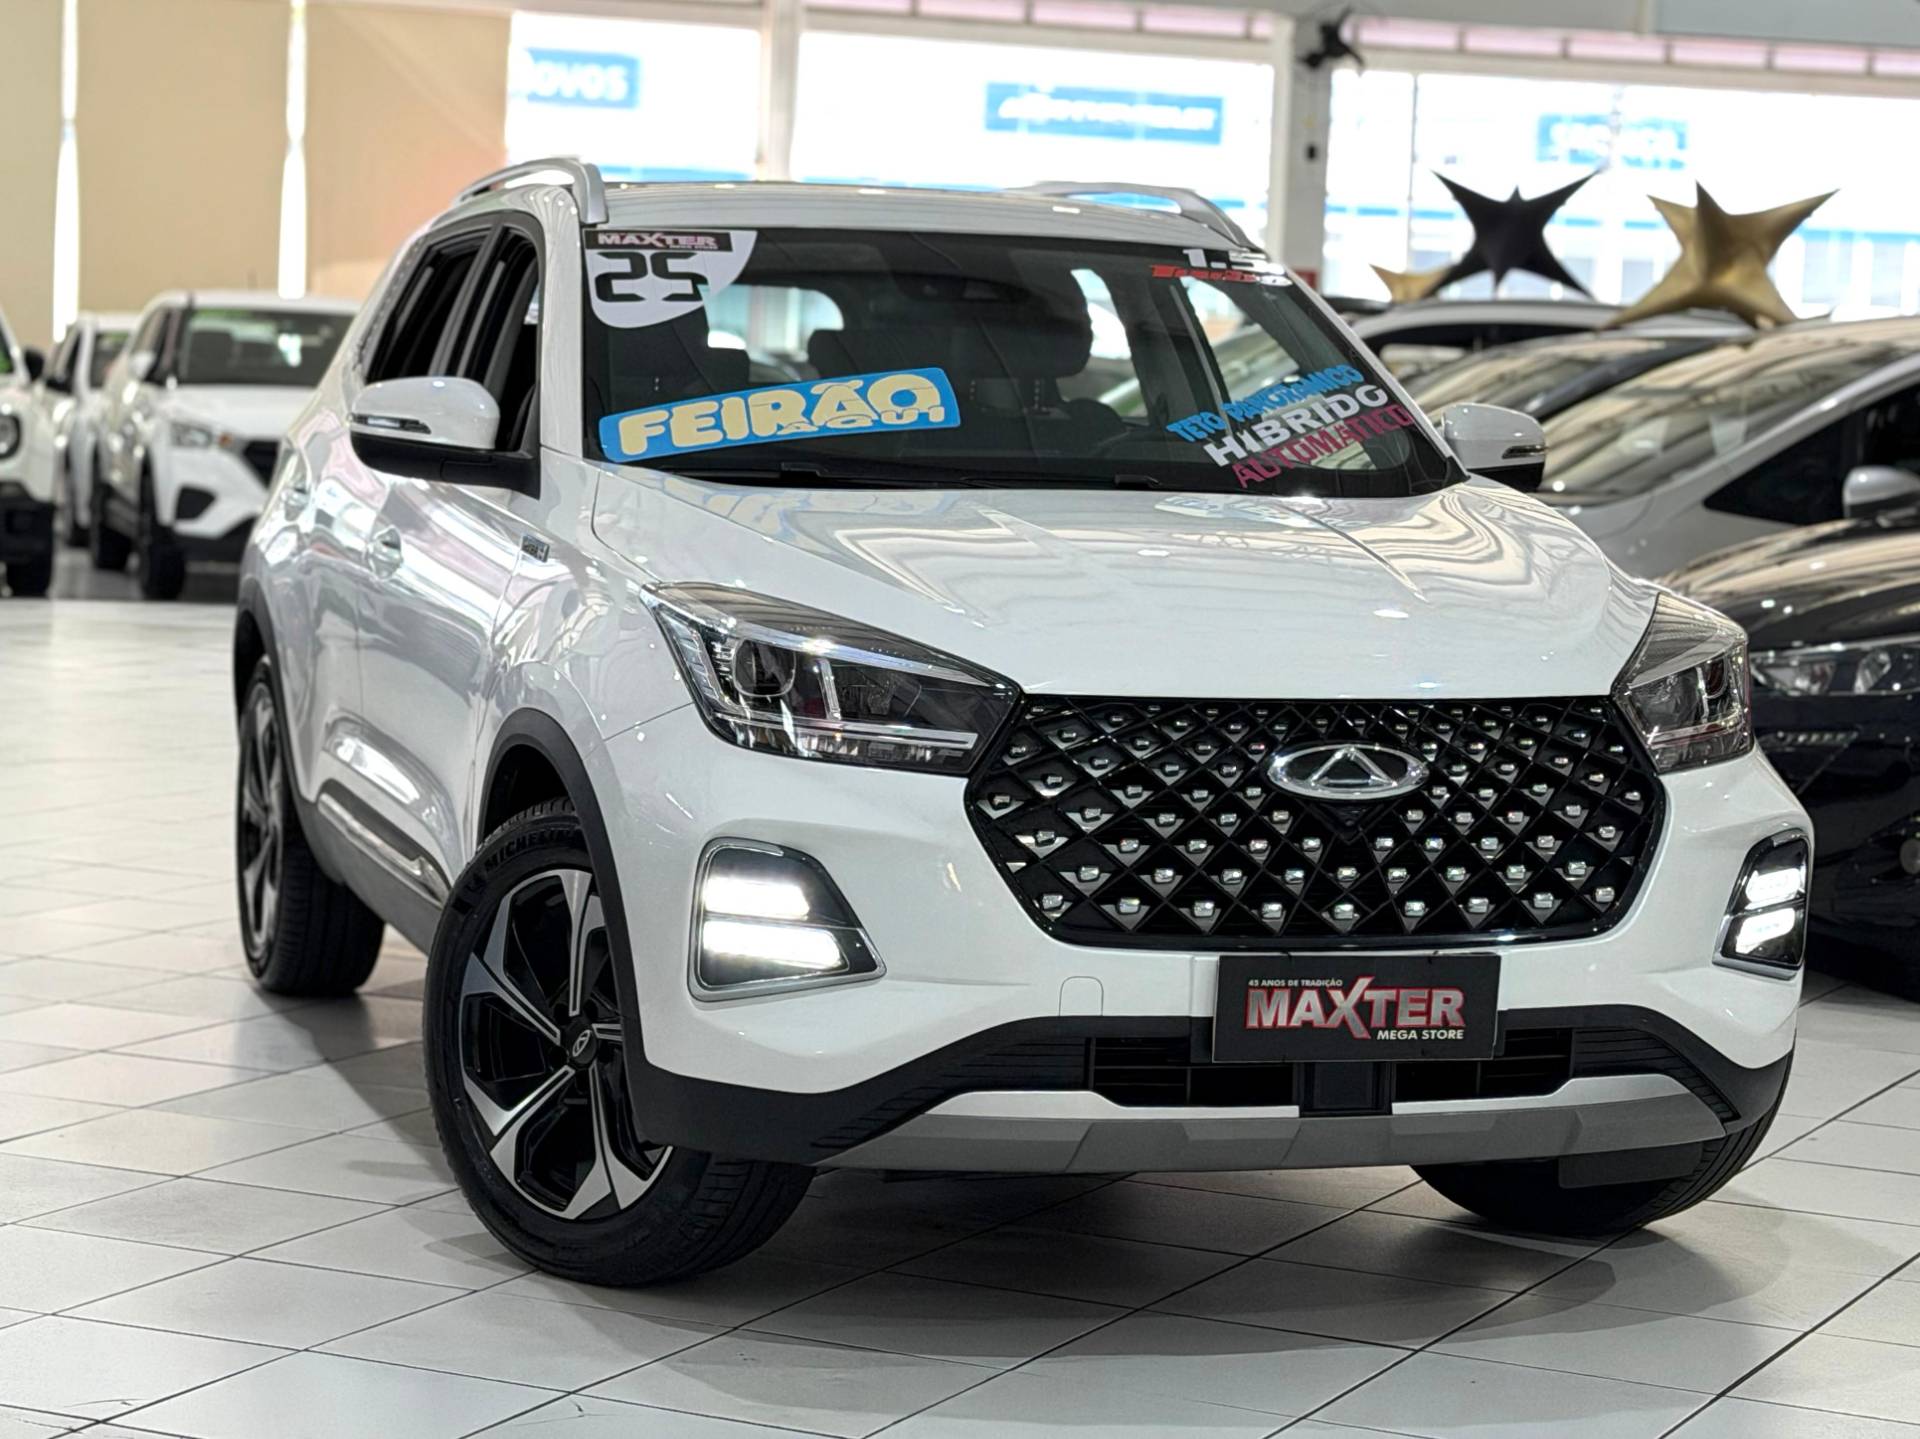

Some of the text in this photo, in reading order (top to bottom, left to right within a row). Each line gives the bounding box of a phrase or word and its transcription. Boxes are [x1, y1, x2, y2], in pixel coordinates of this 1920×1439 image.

[597, 232, 718, 247] MAXTER
[594, 251, 709, 302] 25
[618, 373, 941, 456] FEIRÃO
[1166, 411, 1228, 442] TETO
[1261, 979, 1286, 987] ANOS
[1288, 979, 1299, 987] DE
[1301, 978, 1343, 988] TRADIÇÃO
[1246, 975, 1466, 1039] MAXTER
[1377, 1029, 1464, 1040] MEGA STORE
